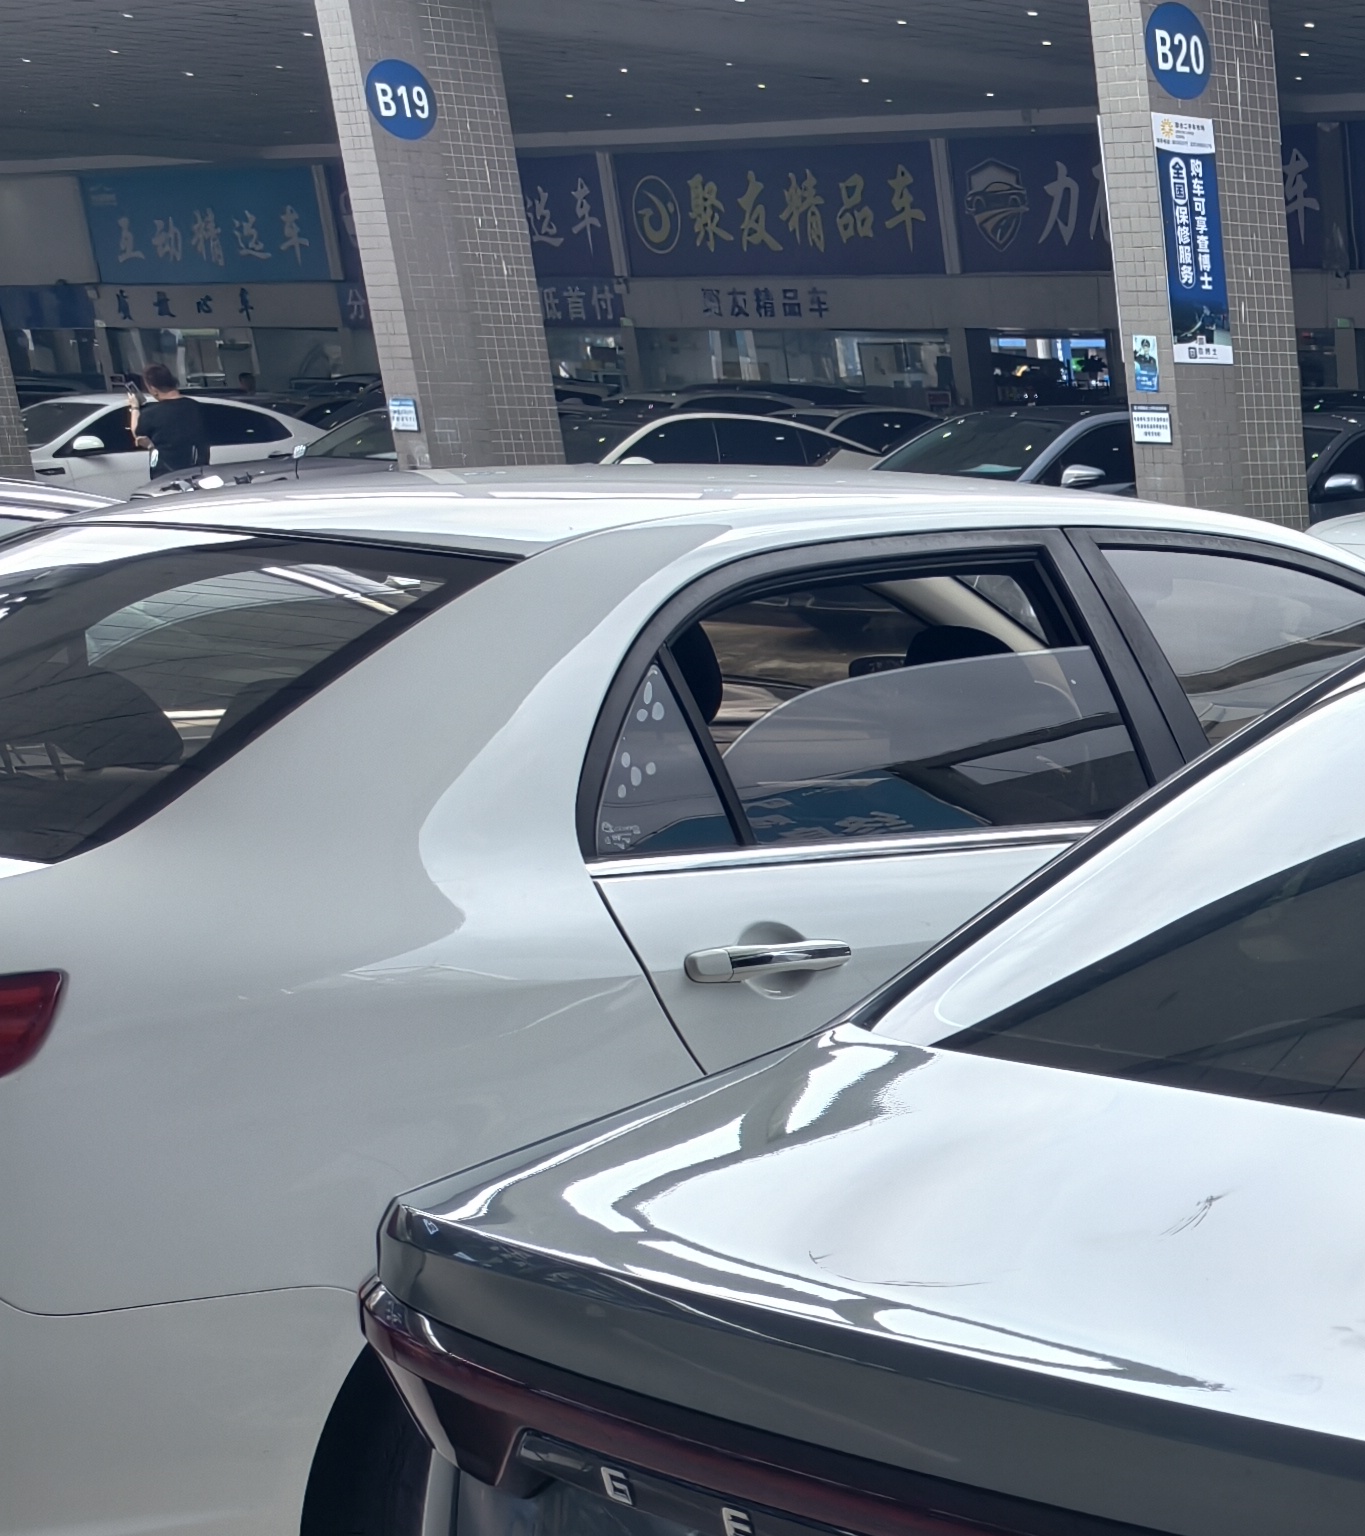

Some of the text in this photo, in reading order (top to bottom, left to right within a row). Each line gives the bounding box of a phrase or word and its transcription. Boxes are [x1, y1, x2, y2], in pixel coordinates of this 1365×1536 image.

[1155, 29, 1205, 75] B20
[375, 82, 430, 119] B19
[117, 204, 310, 267] 互动精选车
[686, 163, 927, 253] 聚友精品车
[1171, 161, 1194, 285] 全国保修服务
[1190, 158, 1214, 290] 购车可享查博士
